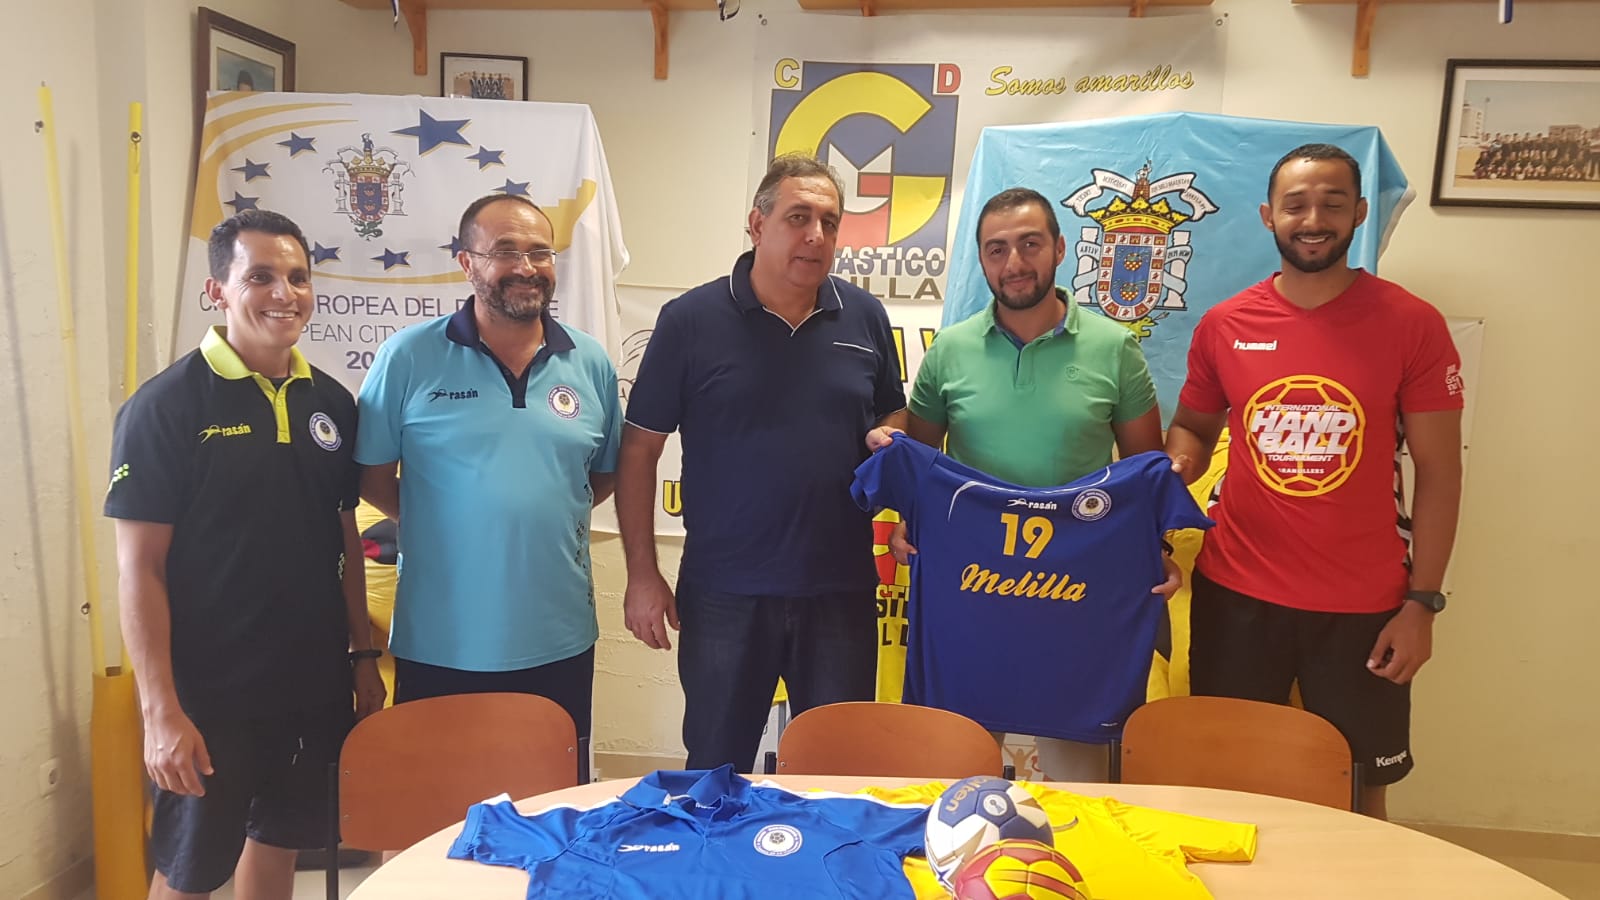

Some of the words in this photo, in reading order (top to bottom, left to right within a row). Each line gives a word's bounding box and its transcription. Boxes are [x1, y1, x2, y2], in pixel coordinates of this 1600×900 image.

[774, 58, 800, 88] C
[937, 63, 961, 93] D
[985, 65, 1067, 96] Somos
[1073, 64, 1195, 93] amarillos
[835, 246, 946, 277] ASTICO
[316, 294, 398, 316] ROPEA
[405, 297, 447, 317] DEL
[1233, 338, 1278, 351] hummel
[1264, 403, 1342, 412] INTERNATIONAL
[1250, 411, 1357, 433] HAND
[1258, 432, 1348, 455] BALL
[1000, 513, 1054, 559] 19
[960, 563, 1087, 602] Melilla
